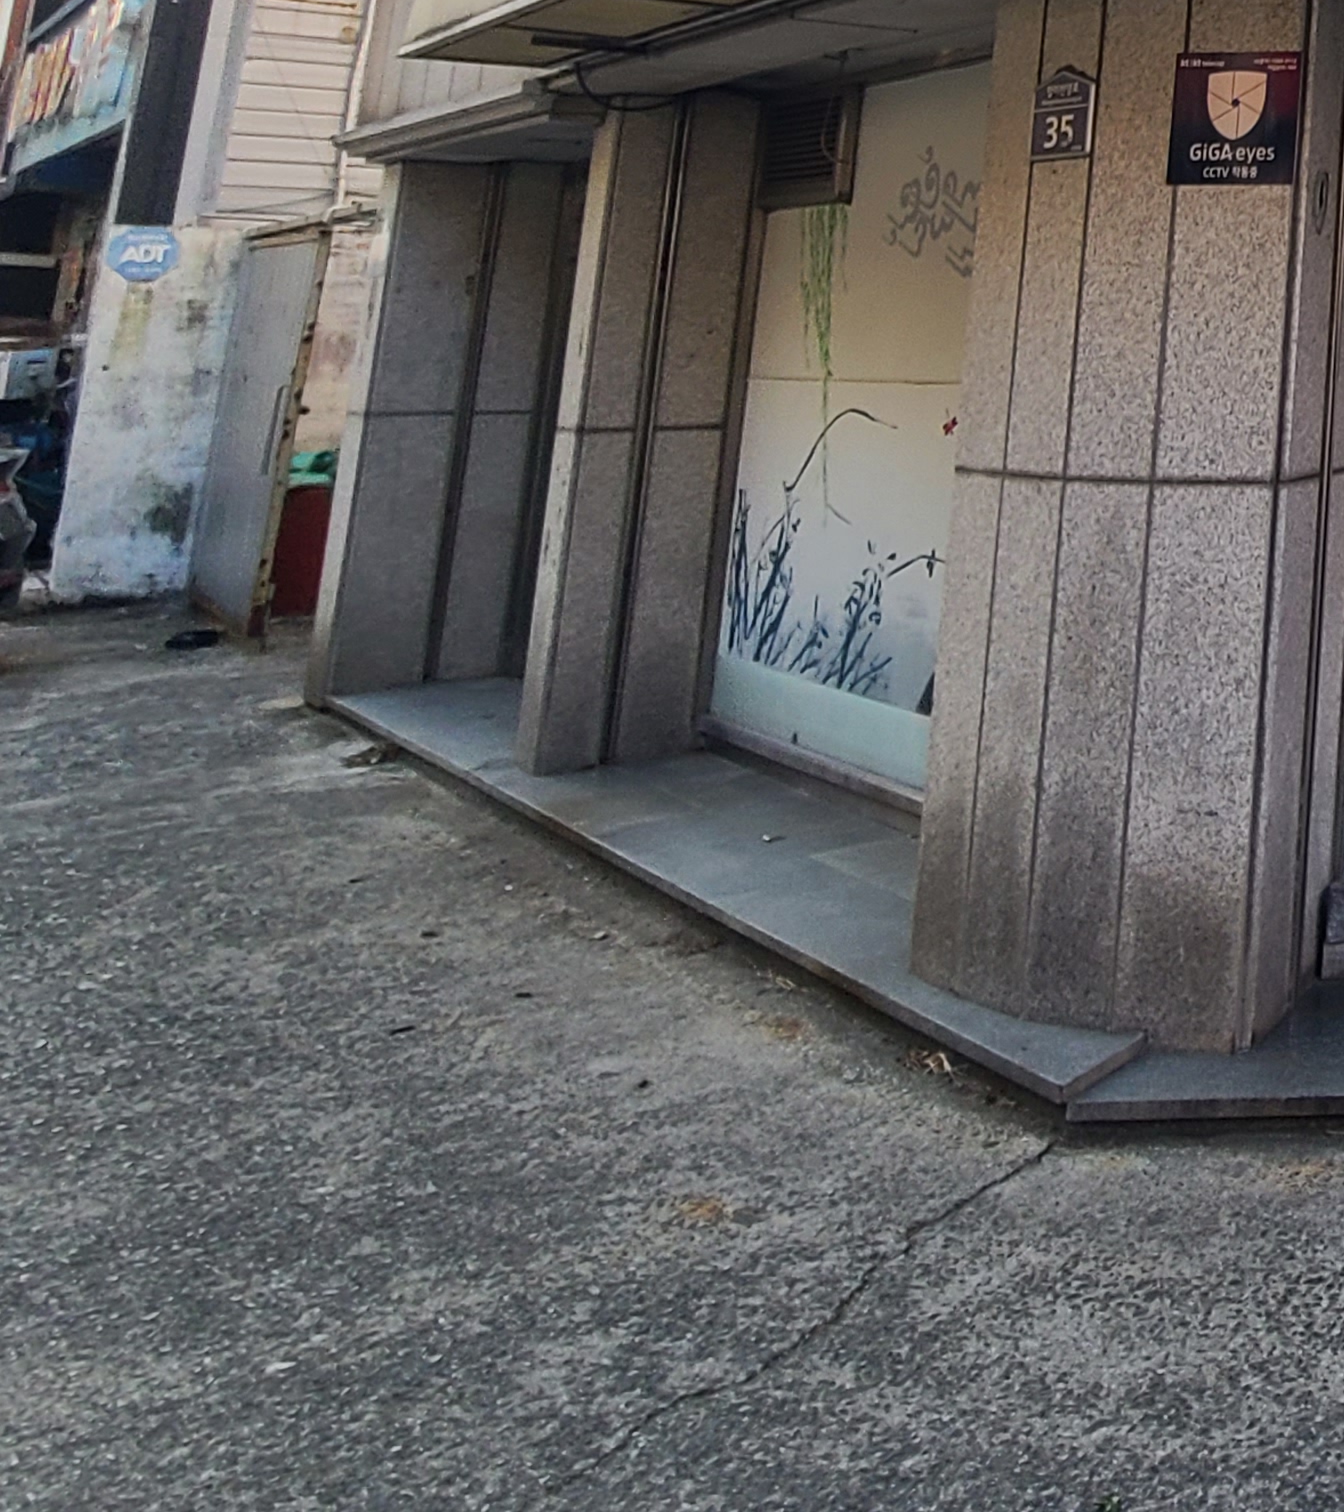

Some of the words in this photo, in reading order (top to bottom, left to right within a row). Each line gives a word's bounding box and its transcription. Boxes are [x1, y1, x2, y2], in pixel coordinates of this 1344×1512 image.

[1043, 113, 1074, 149] 35
[1203, 166, 1230, 179] CCTV
[120, 243, 171, 264] ADT
